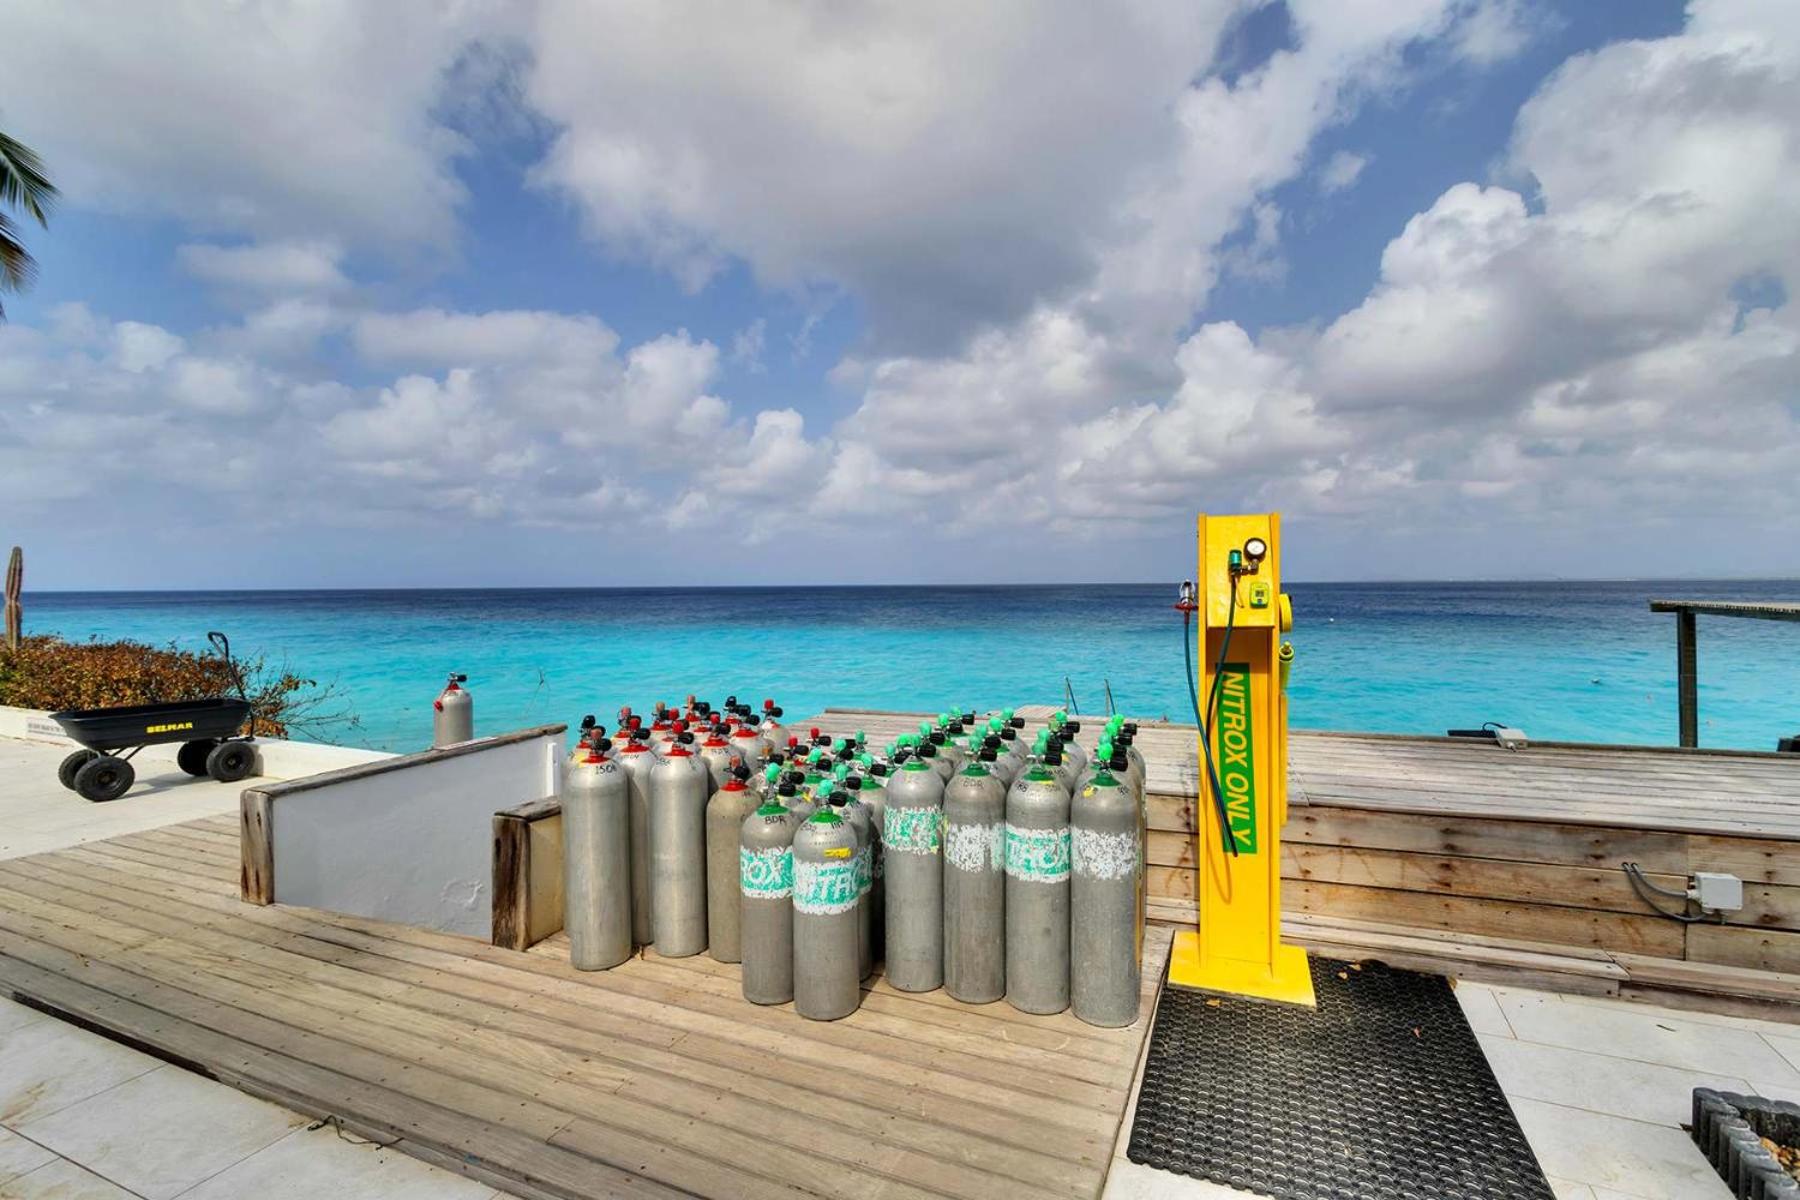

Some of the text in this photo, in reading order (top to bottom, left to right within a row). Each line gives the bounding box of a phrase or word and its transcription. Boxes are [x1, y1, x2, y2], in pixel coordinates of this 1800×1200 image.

[146, 721, 193, 734] BELMAR
[1222, 671, 1252, 847] NITROX ONLY
[765, 815, 787, 827] BDR
